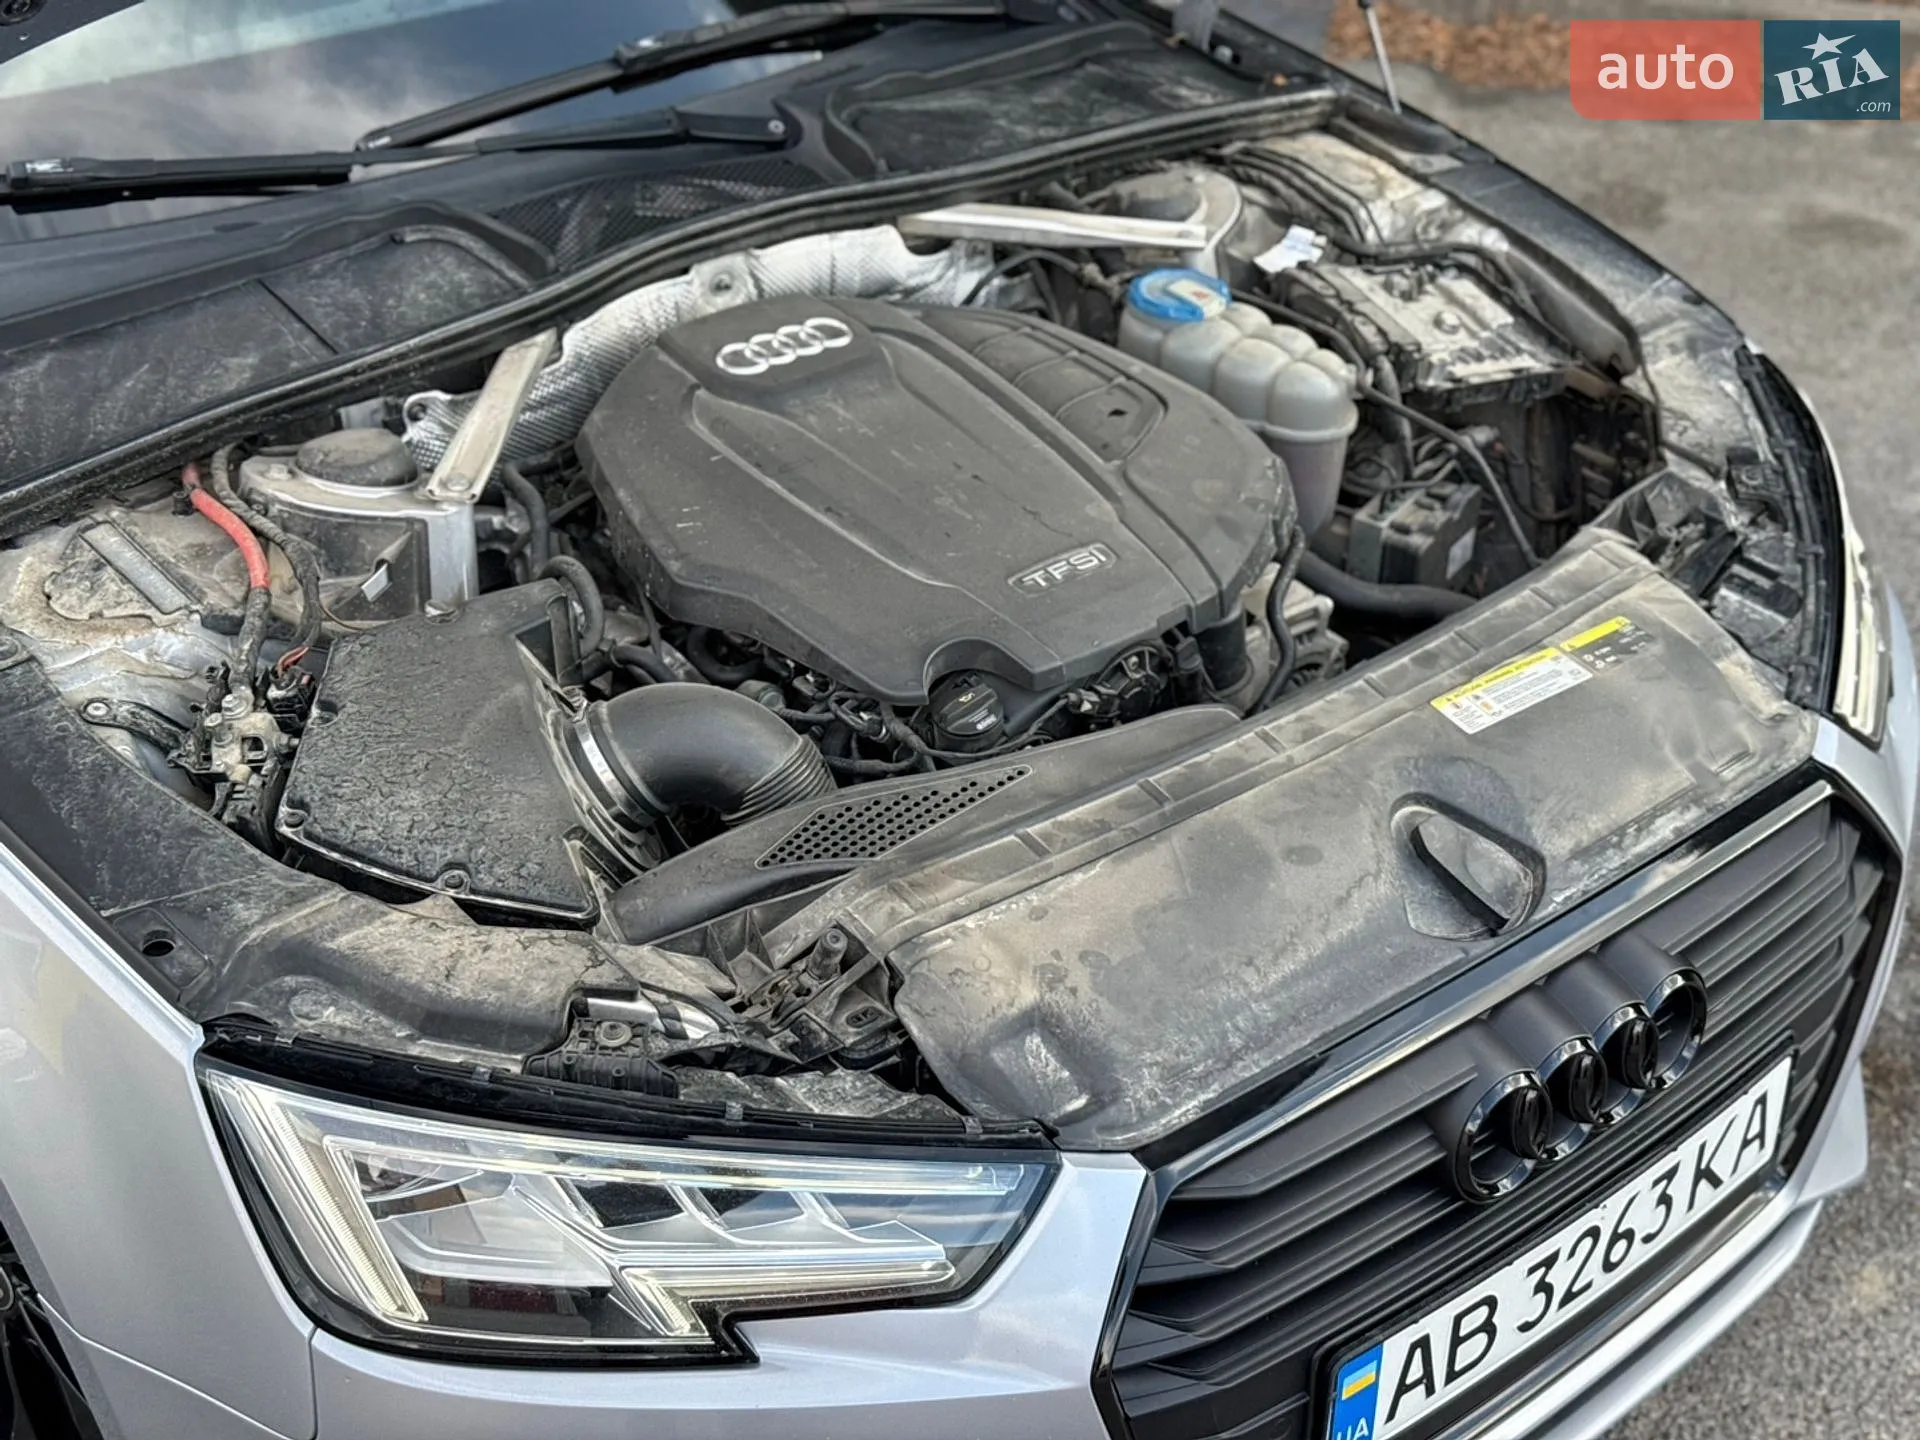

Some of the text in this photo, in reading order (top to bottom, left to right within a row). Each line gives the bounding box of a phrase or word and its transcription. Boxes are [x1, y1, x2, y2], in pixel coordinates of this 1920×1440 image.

[1021, 548, 1108, 588] TFSI
[1384, 1090, 1767, 1424] AB 3263 KA
